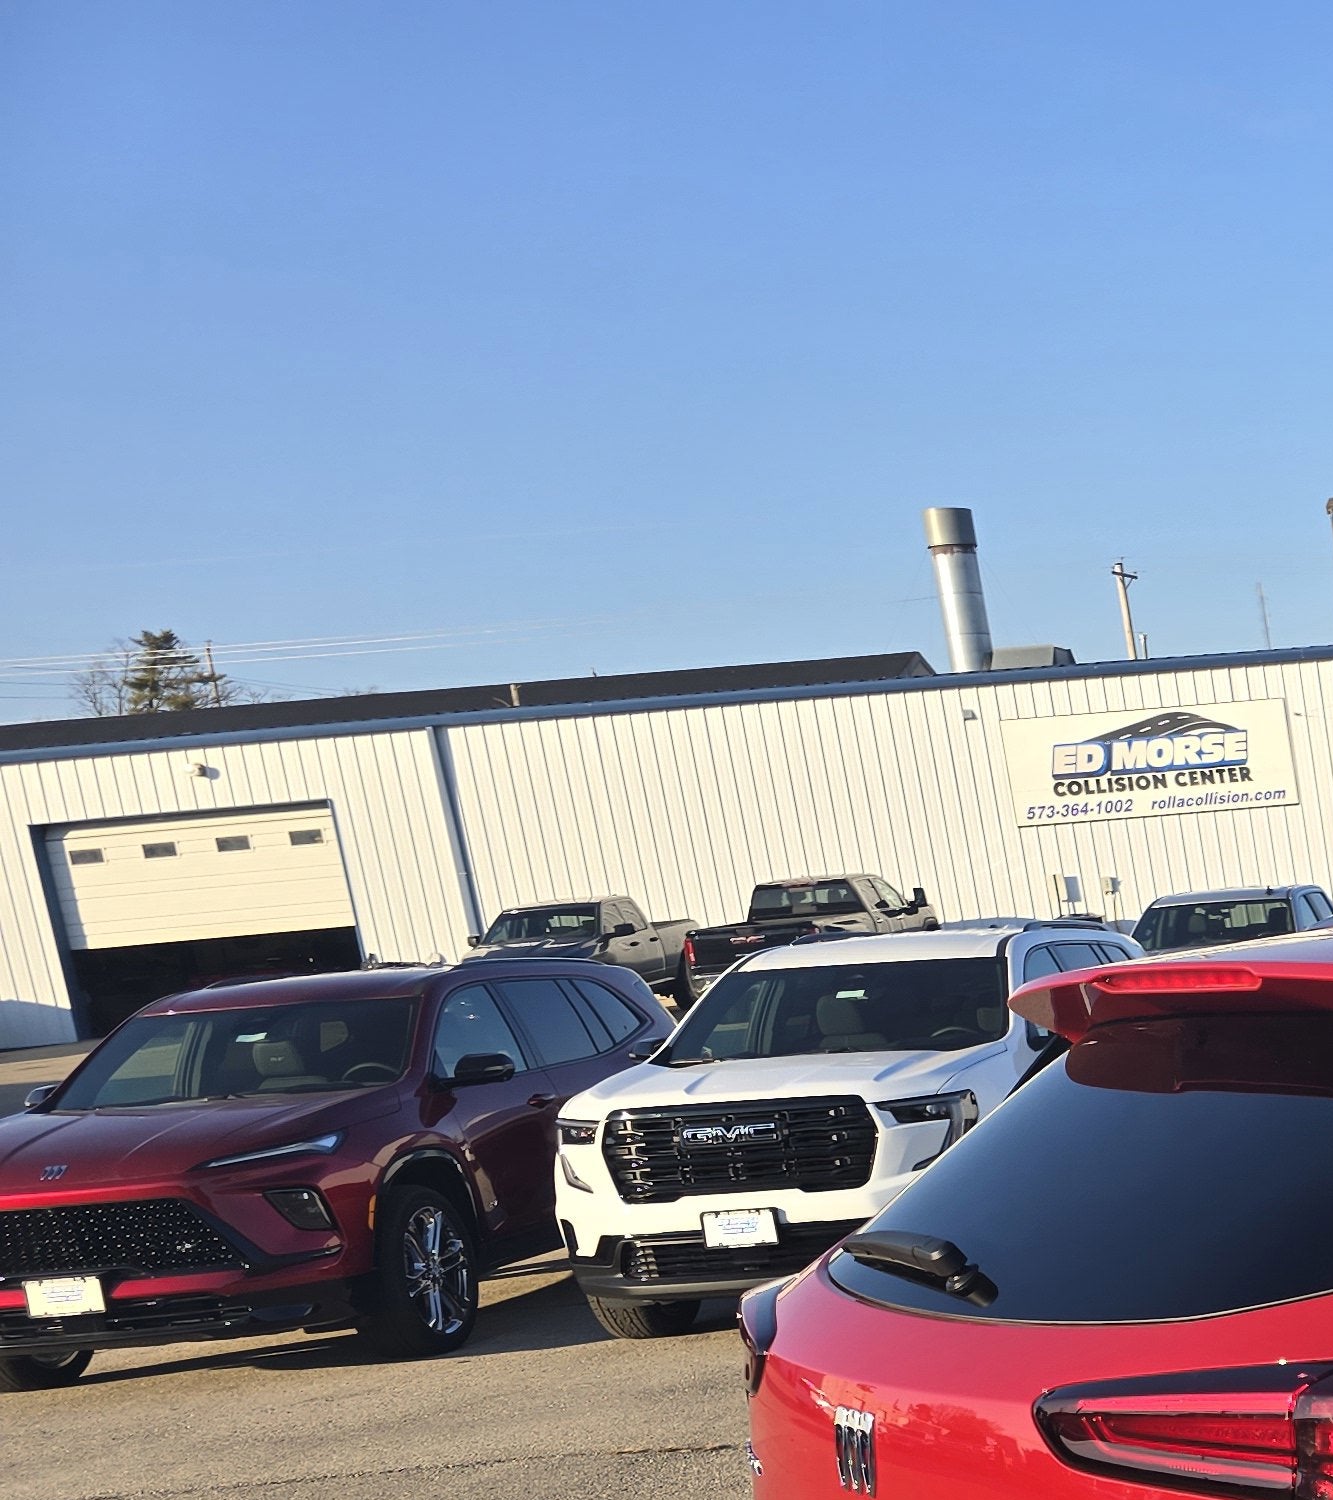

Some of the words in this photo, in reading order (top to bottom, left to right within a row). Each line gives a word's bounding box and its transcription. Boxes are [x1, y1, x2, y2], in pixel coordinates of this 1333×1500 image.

[1052, 742, 1107, 779] ED
[1110, 730, 1248, 775] MORSE
[1053, 773, 1168, 797] COLLISION
[1174, 766, 1254, 788] CENTER
[1027, 799, 1134, 820] 573-364-1002
[1151, 788, 1287, 811] rollacollision.com
[682, 1122, 776, 1145] GMC
